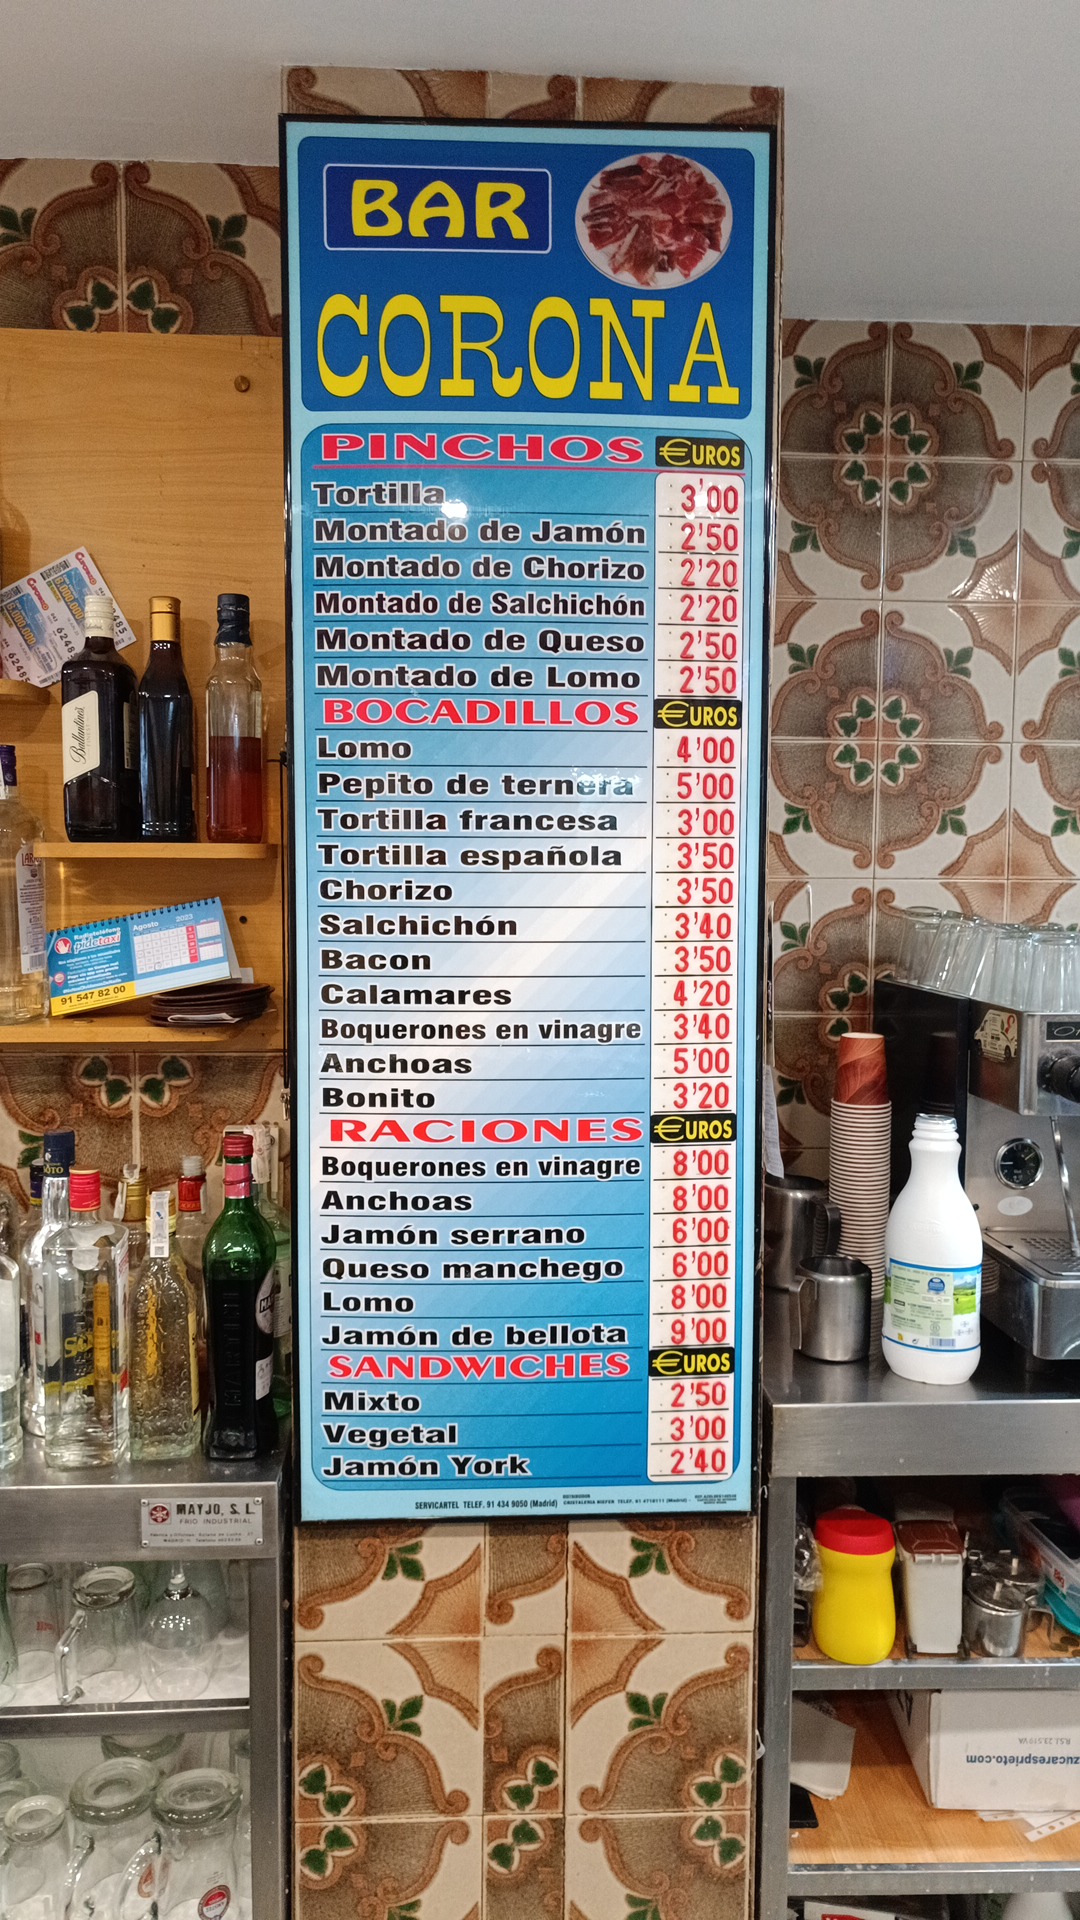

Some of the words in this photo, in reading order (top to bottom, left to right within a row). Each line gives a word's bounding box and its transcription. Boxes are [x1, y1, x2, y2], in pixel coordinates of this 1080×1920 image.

[351, 178, 530, 240] BAR
[317, 293, 739, 405] CORONA
[322, 433, 644, 461] PINCHOS
[659, 438, 740, 467] €UROS
[314, 484, 444, 504] Tortilla
[680, 479, 738, 513] 3'00
[315, 520, 466, 542] Montado
[479, 521, 520, 542] de
[532, 522, 644, 544] Jamón
[680, 523, 738, 550] 2'50
[316, 556, 459, 578] Montado
[473, 557, 510, 578] de
[524, 558, 644, 579] Chorizo
[680, 559, 738, 586] 2'20
[315, 592, 438, 614] Montado
[448, 592, 480, 614] de
[492, 594, 644, 616] Salchichón
[680, 595, 737, 622] 2'20
[316, 630, 468, 651] Montado
[484, 631, 525, 651] de
[539, 630, 644, 654] Queso
[680, 632, 737, 659] 2'50
[317, 666, 476, 686] Montado
[490, 666, 533, 687] de
[547, 666, 640, 688] Lomo
[680, 666, 736, 694] 2'50
[324, 699, 639, 724] BOCADILLOS
[657, 703, 737, 727] €UROS
[318, 738, 412, 759] Lomo
[676, 736, 735, 763] 4'00
[318, 774, 433, 798] Pepito
[447, 774, 488, 795] de
[502, 776, 633, 796] ternera
[676, 772, 735, 800] 5'00
[318, 809, 446, 831] Tortilla
[460, 810, 618, 831] francesa
[676, 808, 735, 836] 3'00
[318, 845, 447, 866] Tortilla
[460, 846, 622, 870] española
[676, 843, 734, 869] 3'50
[319, 880, 452, 901] Chorizo
[676, 877, 734, 904] 3'50
[132, 921, 159, 932] Agosto
[175, 913, 194, 923] 2023
[320, 915, 517, 936] Salchichón
[676, 912, 732, 939] 3'40
[73, 931, 122, 955] pidetaxi
[321, 950, 431, 970] Bacon
[675, 946, 731, 973] 3'50
[60, 996, 73, 1005] 91
[76, 992, 95, 1002] 547
[97, 988, 110, 998] 82
[113, 985, 126, 994] 00
[321, 984, 511, 1005] Calamares
[673, 980, 731, 1006] 4'20
[322, 1019, 485, 1043] Boquerones
[497, 1024, 528, 1040] en
[540, 1019, 641, 1043] vinagre
[673, 1013, 730, 1040] 3'40
[320, 1054, 472, 1074] Anchoas
[673, 1047, 730, 1074] 5'00
[322, 1088, 435, 1108] Bonito
[673, 1082, 730, 1109] 3'20
[330, 1118, 643, 1143] RACIONES
[653, 1115, 732, 1141] €UROS
[322, 1157, 485, 1181] Boquerones
[497, 1162, 528, 1176] en
[540, 1156, 640, 1179] vinagre
[673, 1149, 730, 1176] 8'00
[322, 1192, 472, 1211] Anchoas
[672, 1184, 730, 1211] 8'00
[322, 1224, 437, 1245] Jamón
[450, 1228, 586, 1245] serrano
[672, 1218, 729, 1245] 6'00
[322, 1258, 429, 1280] Queso
[443, 1258, 624, 1282] manchego
[672, 1251, 729, 1278] 6'00
[323, 1293, 414, 1313] Lomo
[671, 1282, 727, 1310] 8'00
[322, 1326, 438, 1346] Jamón
[452, 1326, 492, 1346] de
[506, 1325, 627, 1345] bellota
[670, 1316, 727, 1345] 9'00
[329, 1353, 630, 1379] SANDWICHES
[652, 1351, 730, 1375] €UROS
[324, 1392, 420, 1412] Mixto
[670, 1381, 726, 1408] 2'50
[322, 1424, 457, 1446] Vegetal
[670, 1415, 726, 1442] 3'00
[323, 1456, 438, 1476] Jamón
[451, 1454, 529, 1476] York
[670, 1447, 726, 1474] 2'40
[176, 1503, 224, 1517] MAYJO,
[415, 1500, 460, 1510] SERVICARTEL
[463, 1500, 485, 1509] TELEF.
[486, 1500, 495, 1509] 91
[497, 1500, 510, 1509] 434
[511, 1499, 528, 1508] 9050
[529, 1499, 558, 1509] (Madrid)
[966, 1754, 1080, 1767] zucaresprieto.com
